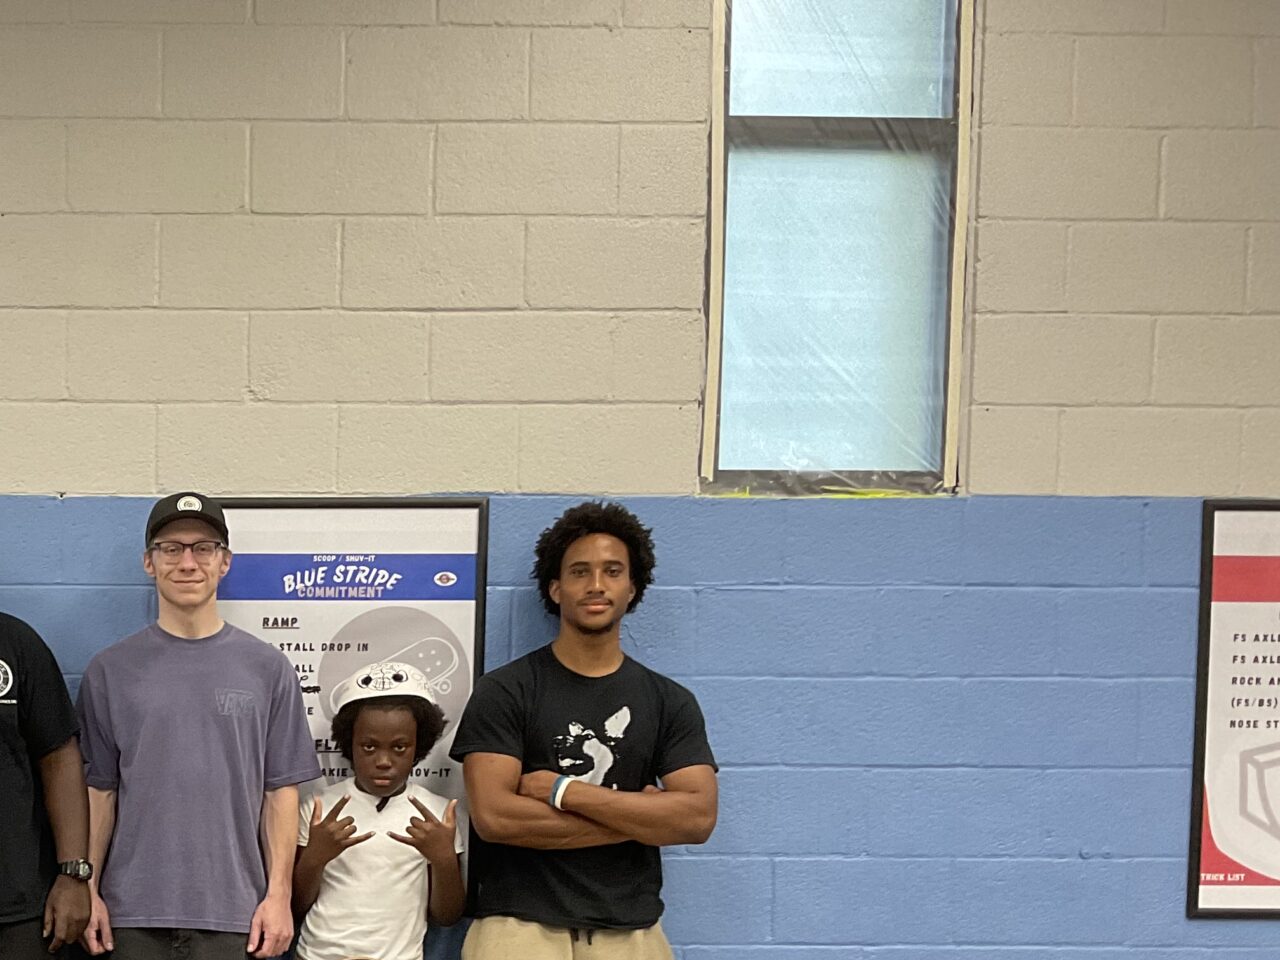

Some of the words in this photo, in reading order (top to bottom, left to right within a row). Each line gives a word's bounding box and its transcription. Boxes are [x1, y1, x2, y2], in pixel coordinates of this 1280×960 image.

[312, 554, 336, 562] SCOOP
[283, 565, 328, 593] BLUE
[333, 564, 402, 590] STRIPE
[297, 586, 384, 598] COMMITMENT
[262, 617, 298, 628] RAMP
[1233, 633, 1246, 642] FS
[279, 642, 315, 652] STALL
[321, 643, 351, 652] DROP
[357, 643, 369, 652] IN
[1232, 655, 1246, 664] FS
[1231, 676, 1261, 686] ROCK
[1229, 719, 1259, 729] NOSE
